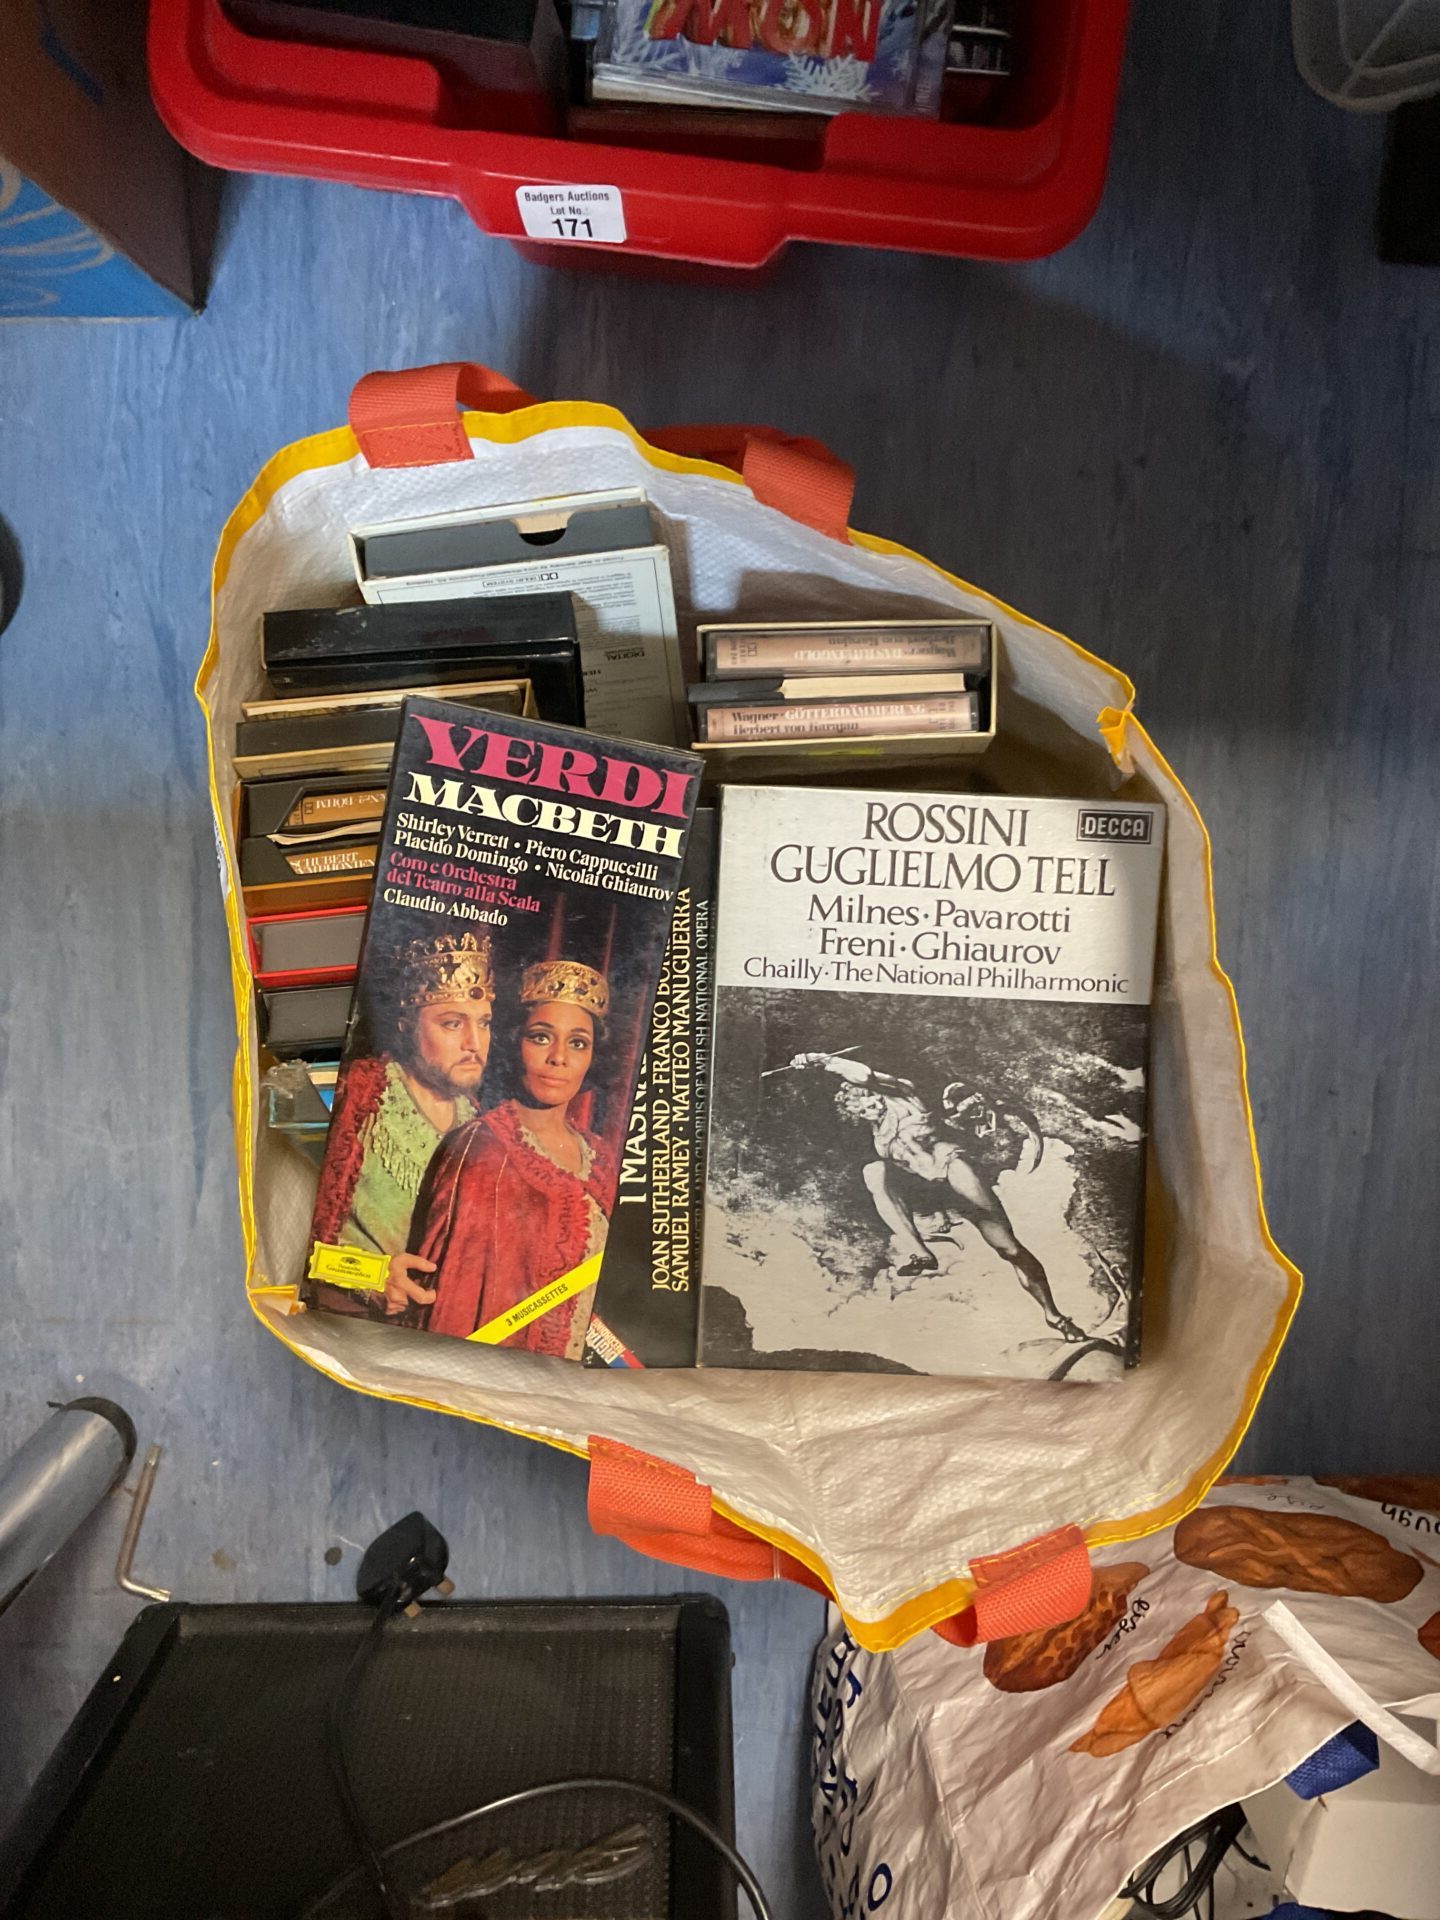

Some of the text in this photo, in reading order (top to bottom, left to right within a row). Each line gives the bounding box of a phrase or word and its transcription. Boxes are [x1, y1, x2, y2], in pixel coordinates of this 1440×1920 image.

[524, 191, 610, 203] Badgers Auctions
[550, 206, 565, 215] Lot
[551, 218, 593, 238] 171
[732, 711, 779, 724] Wagner
[733, 723, 780, 735] Herbert
[409, 714, 696, 819] VERDI
[403, 771, 686, 859] MACBETH
[862, 801, 1031, 848] ROSSINI
[1083, 815, 1146, 838] DECCA
[393, 830, 675, 902] Placido Domingo Nicolai Ghiaurov
[396, 812, 659, 881] Shirley Verrett Piero Cappuccilli
[386, 867, 541, 913] del Teatro alla Scala
[389, 850, 518, 891] Coro e Orchestra
[769, 843, 1117, 897] GUGLIELMO TELL
[383, 887, 509, 927] Claudio Abbado
[695, 899, 709, 950] OPERA
[807, 894, 1071, 934] Milnes Pavarotti
[818, 927, 1062, 965] Freni Ghiaurov
[695, 952, 709, 1022] NATIONAL
[743, 956, 1130, 995] Chailly The National Philharmonic
[652, 1001, 671, 1086] FRANCO
[671, 887, 691, 1292] SAMUEL RAMEY MATTEO MANUGUERRA
[651, 1098, 671, 1235] SUTHERLAND
[619, 1192, 647, 1206] I
[651, 1240, 672, 1291] JOAN
[505, 1282, 569, 1327] 3 MUSICASSETTES
